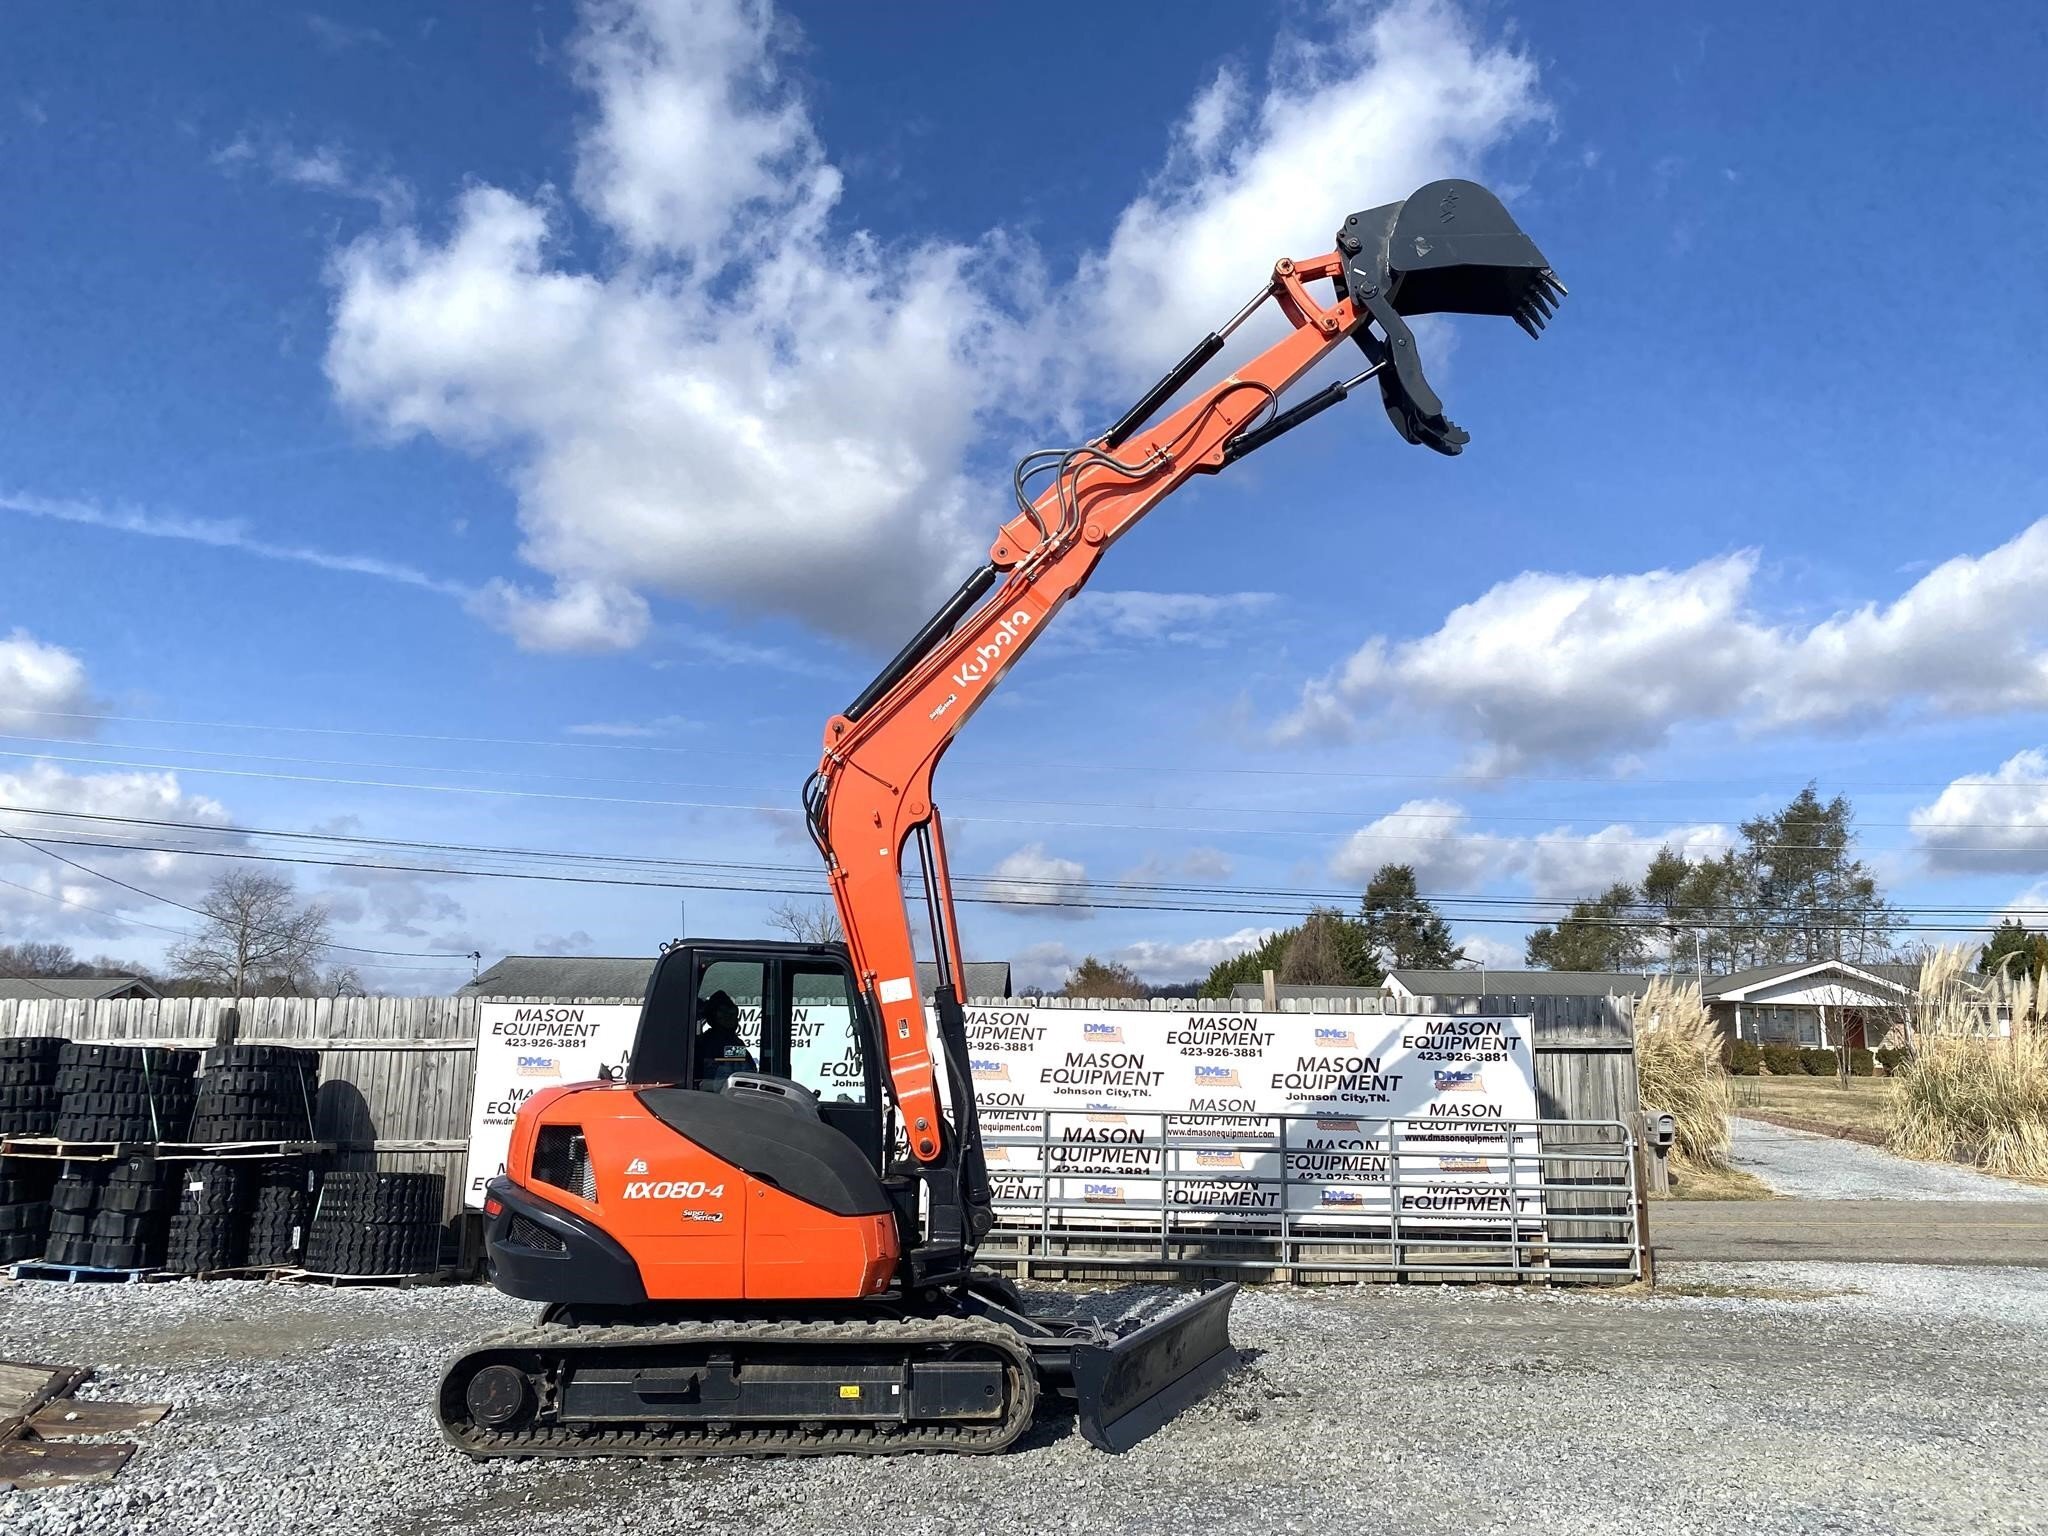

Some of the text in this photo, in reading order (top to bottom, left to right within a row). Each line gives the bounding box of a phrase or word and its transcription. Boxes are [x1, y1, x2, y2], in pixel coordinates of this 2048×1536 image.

[951, 610, 1032, 688] Kubota
[514, 1009, 584, 1022] MASON
[963, 1011, 1030, 1026] MASON
[492, 1022, 600, 1037] EQUIPMENT
[1187, 1017, 1258, 1031] MASON
[1425, 1021, 1502, 1036] MASON
[965, 1026, 1047, 1041] UIPMENT
[1166, 1031, 1276, 1046] EQUIPMENT
[504, 1038, 587, 1048] 423-926-3881
[966, 1041, 1034, 1051] 3-926-3881
[1402, 1035, 1522, 1051] EQUIPMENT
[1180, 1047, 1263, 1058] 423-926-3881
[1417, 1051, 1509, 1061] 423-926-3881
[1064, 1052, 1145, 1069] MASON
[1296, 1056, 1381, 1073] MASON
[832, 1079, 865, 1088] Johns
[1040, 1068, 1165, 1087] EQUIPMENT
[1271, 1073, 1403, 1092] EQUIPMENT
[975, 1092, 1025, 1106] ASON
[1053, 1086, 1152, 1098] Johnson City,TN.
[1285, 1092, 1390, 1104] Johnson City,TN.
[1188, 1098, 1256, 1112] MASON
[1429, 1103, 1503, 1118] MASON
[1063, 1127, 1145, 1144] MASON
[1306, 1139, 1380, 1151] MASON
[1286, 1154, 1399, 1172] EQUIPMEN
[622, 1181, 725, 1199] KX080-4
